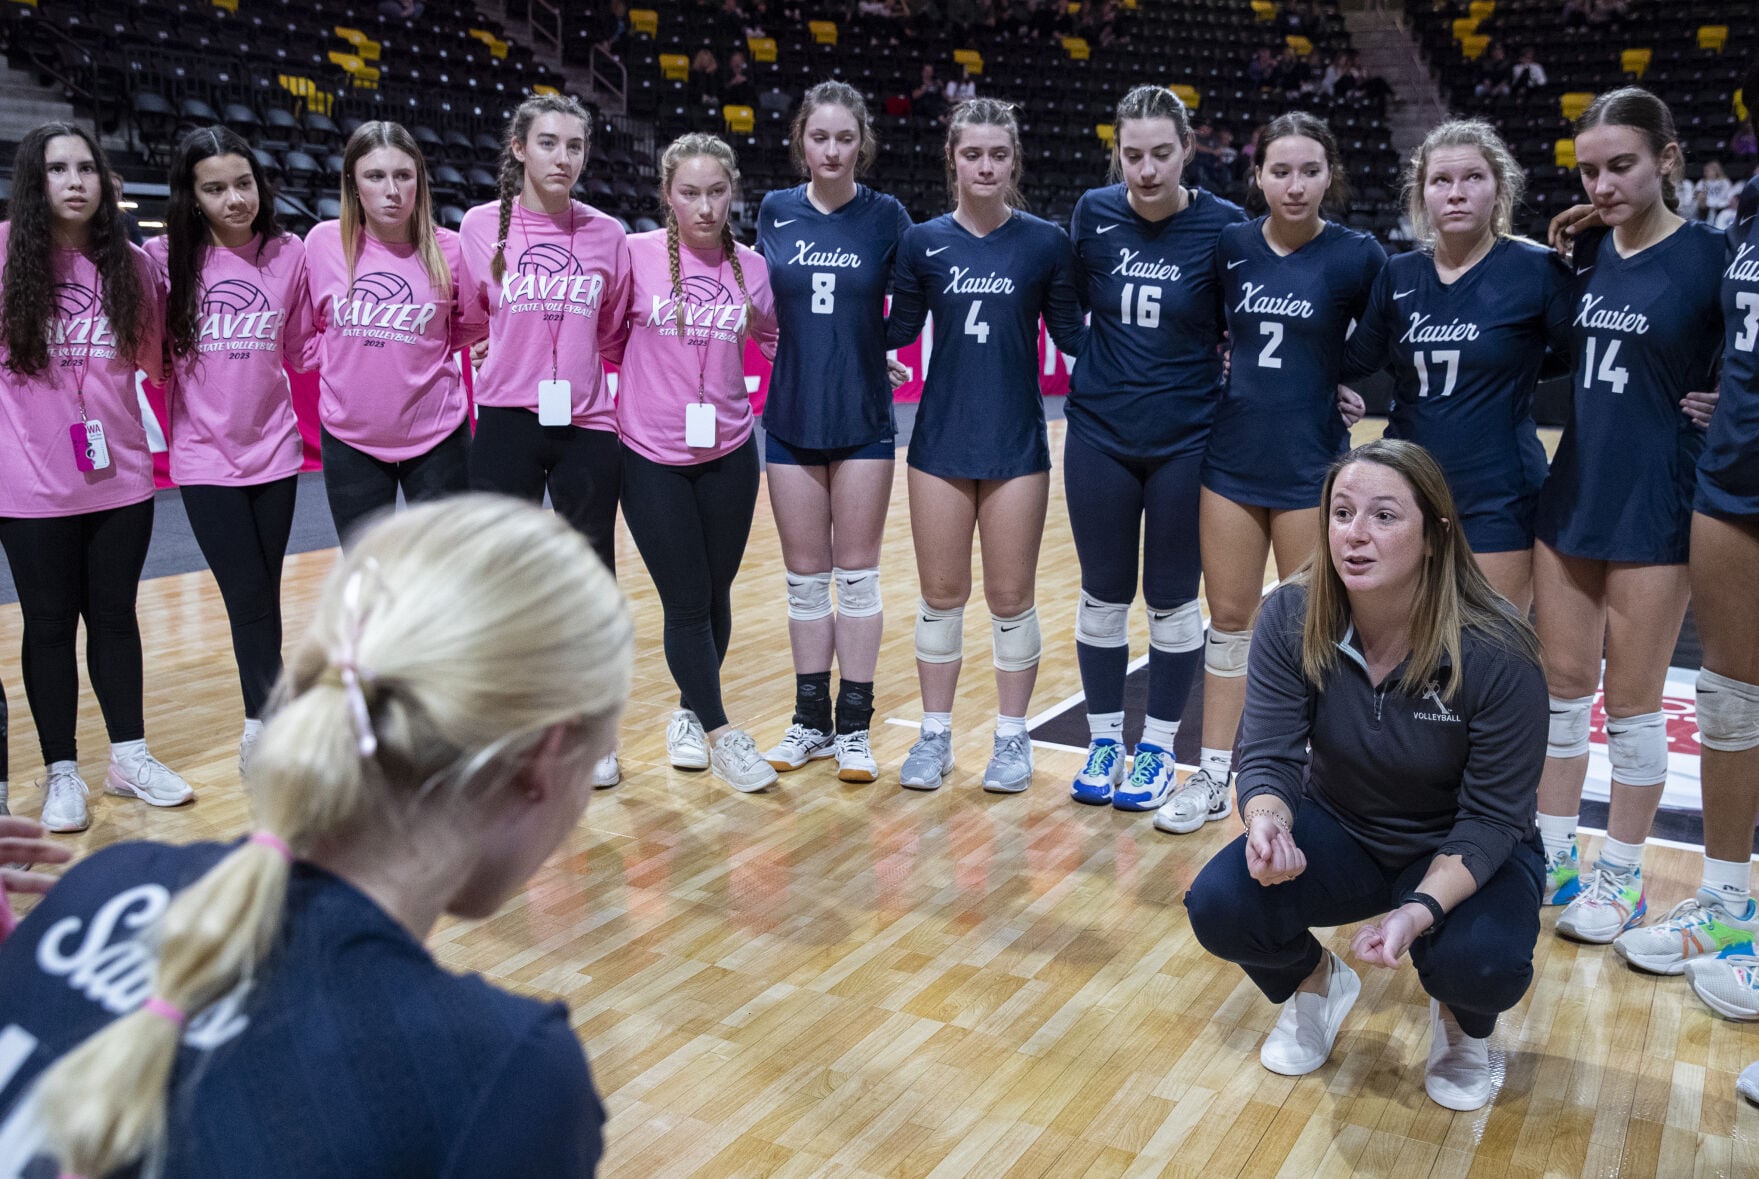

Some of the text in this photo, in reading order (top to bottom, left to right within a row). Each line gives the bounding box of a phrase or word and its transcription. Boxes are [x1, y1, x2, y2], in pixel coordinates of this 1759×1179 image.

[787, 240, 862, 269] Xavier
[1111, 247, 1182, 282] Xavier
[499, 271, 603, 310] XAVIER
[811, 272, 836, 315] 8
[943, 266, 1015, 295] Xavier
[332, 293, 437, 336] XAVIER
[511, 302, 593, 319] STATE VOLLEYBALL
[1120, 282, 1163, 329] 16
[1234, 281, 1314, 319] Xavier
[1572, 292, 1650, 335] Xavier
[363, 328, 417, 345] VOLLEYBALL
[964, 299, 990, 344] 4
[1399, 311, 1480, 344] Xavier
[229, 352, 250, 360] 2023
[364, 339, 385, 348] 2023
[1258, 320, 1284, 369] 2
[1413, 349, 1461, 397] 17
[1583, 336, 1630, 394] 14
[1413, 711, 1462, 723] VOLLEYBALL
